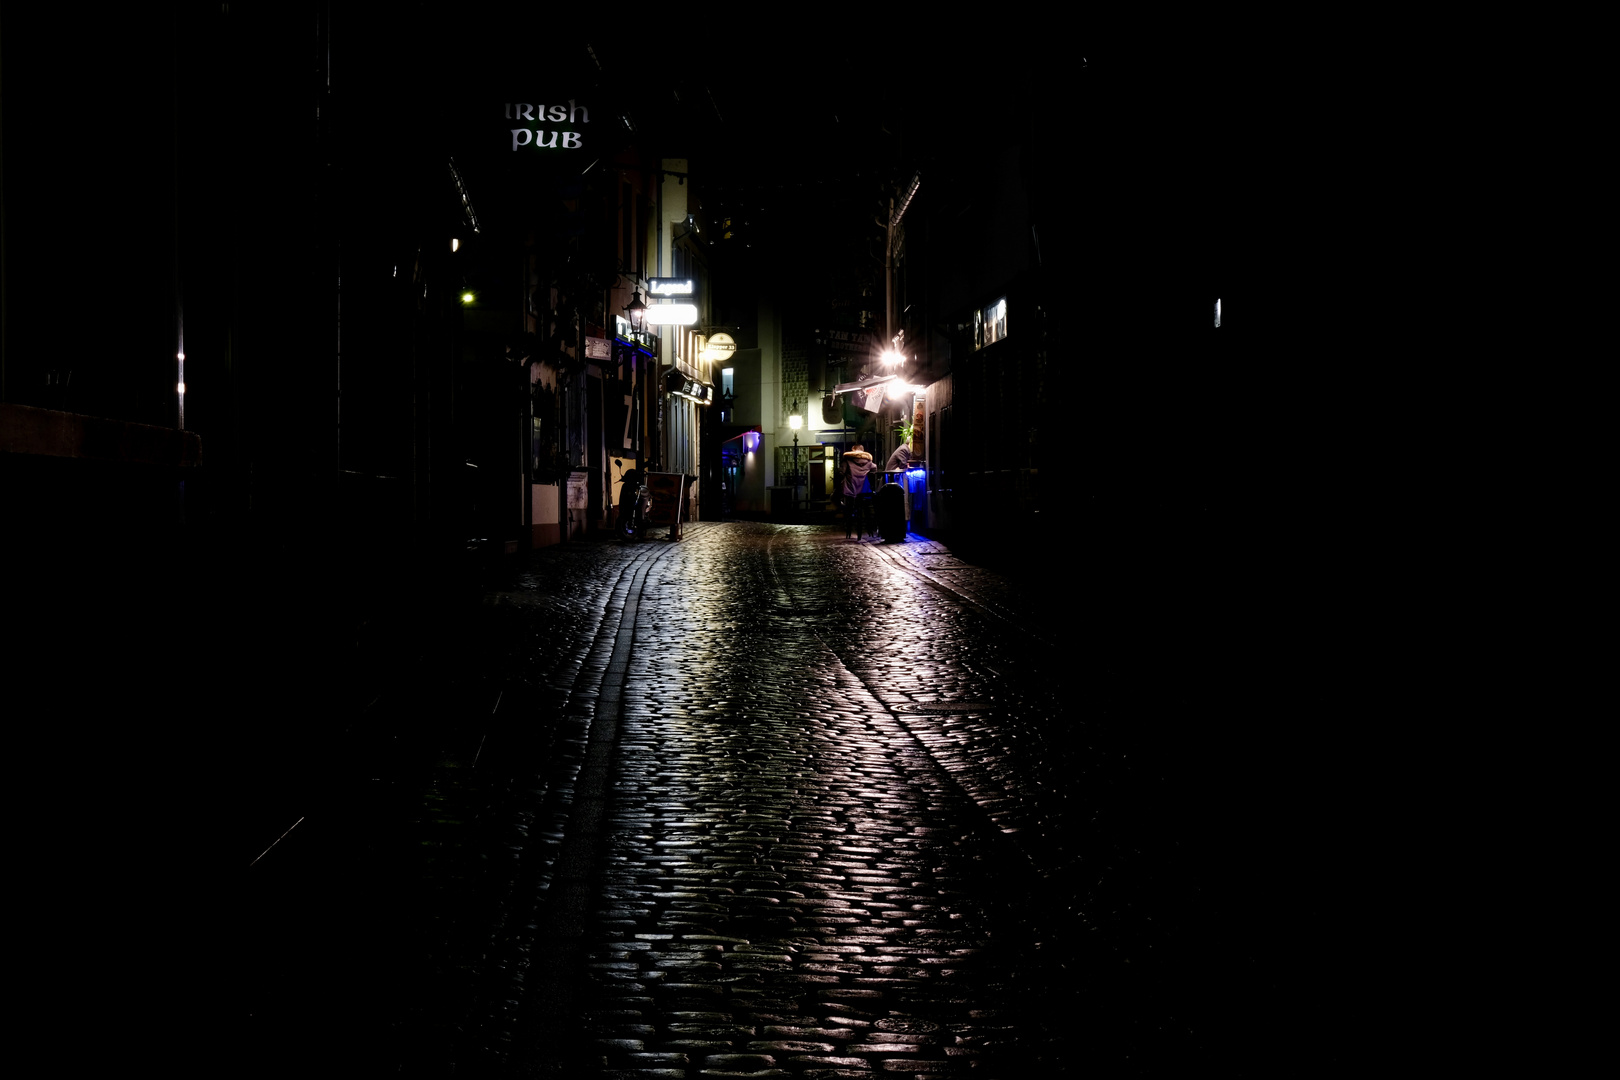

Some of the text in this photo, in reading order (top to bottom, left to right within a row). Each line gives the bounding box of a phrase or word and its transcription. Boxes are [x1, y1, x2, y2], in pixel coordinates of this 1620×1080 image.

[505, 99, 590, 123] IRISH
[511, 128, 583, 152] PUB
[651, 280, 692, 296] Legend
